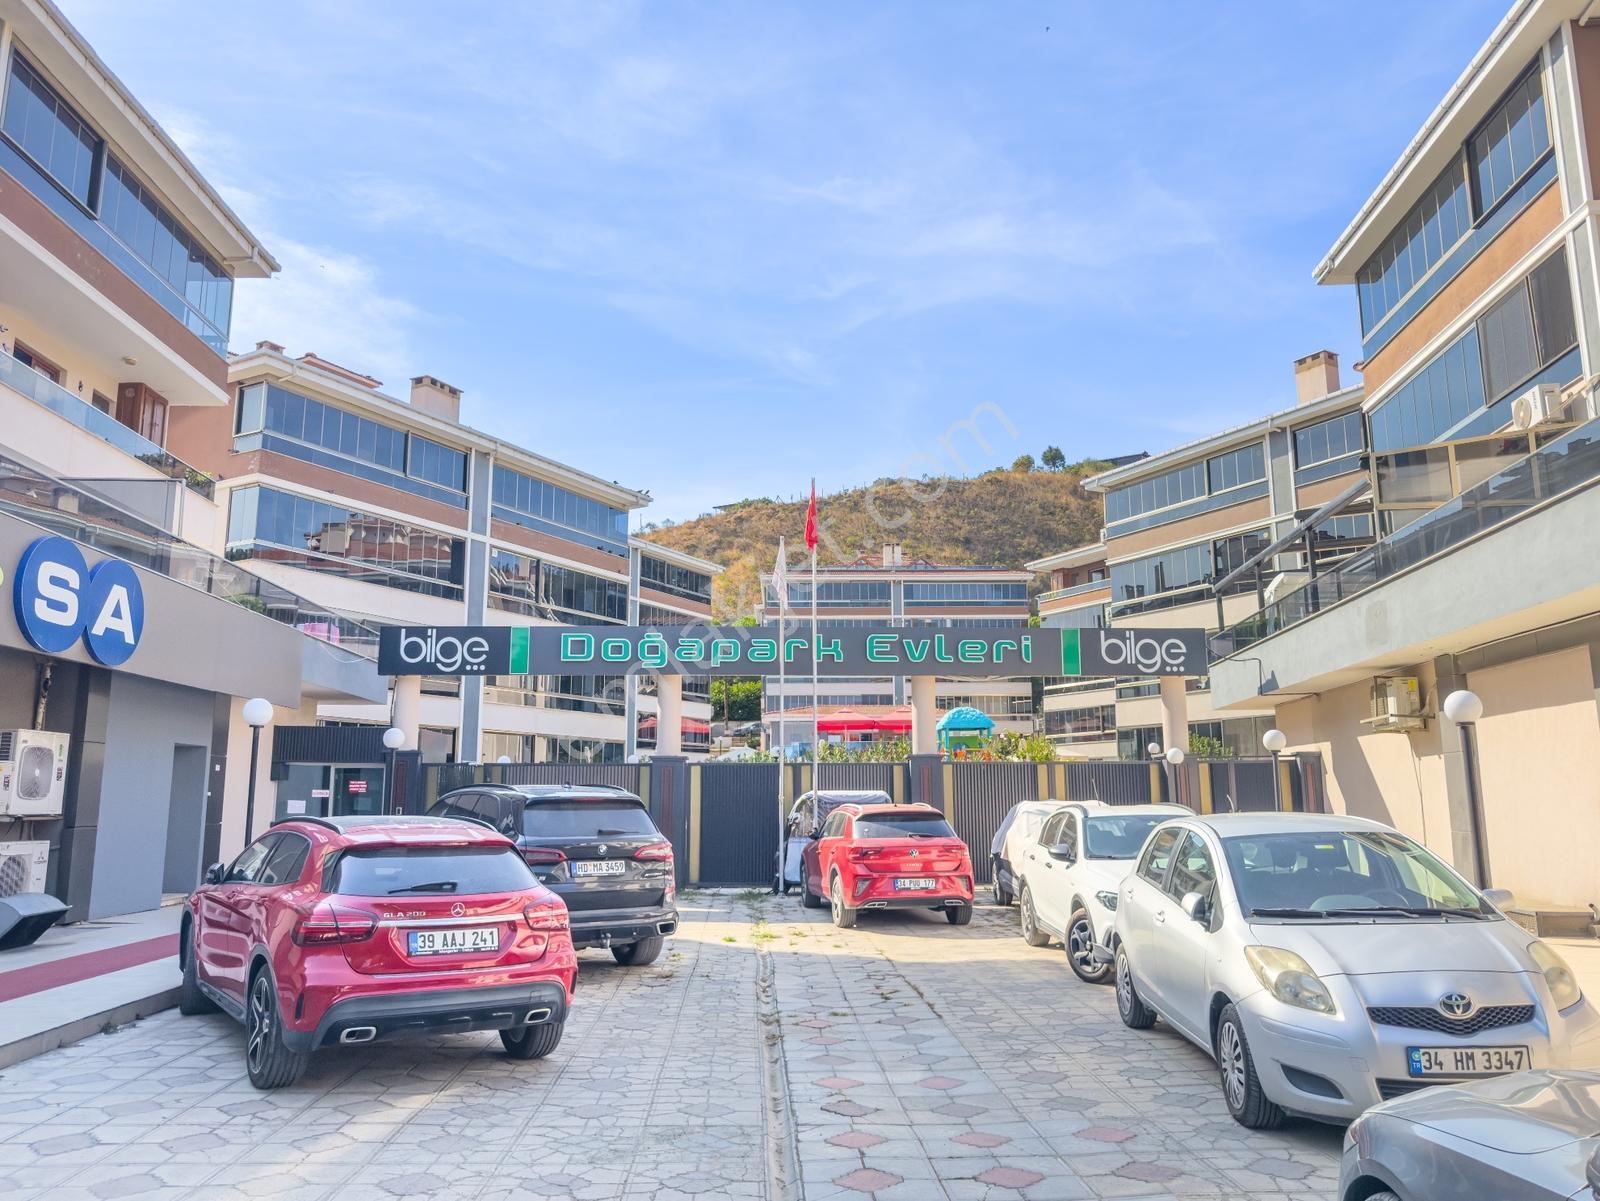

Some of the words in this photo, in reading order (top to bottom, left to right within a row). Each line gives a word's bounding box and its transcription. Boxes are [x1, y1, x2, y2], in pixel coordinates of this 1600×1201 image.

[400, 628, 490, 672] bilge
[560, 632, 844, 668] Doğapark
[866, 632, 1034, 664] Evleri
[1099, 629, 1187, 674] bilge
[418, 933, 435, 949] 39
[442, 932, 466, 948] AAJ
[472, 930, 495, 946] 241
[1421, 1051, 1444, 1071] 34
[1453, 1051, 1476, 1071] HM
[1481, 1050, 1525, 1071] 3347
